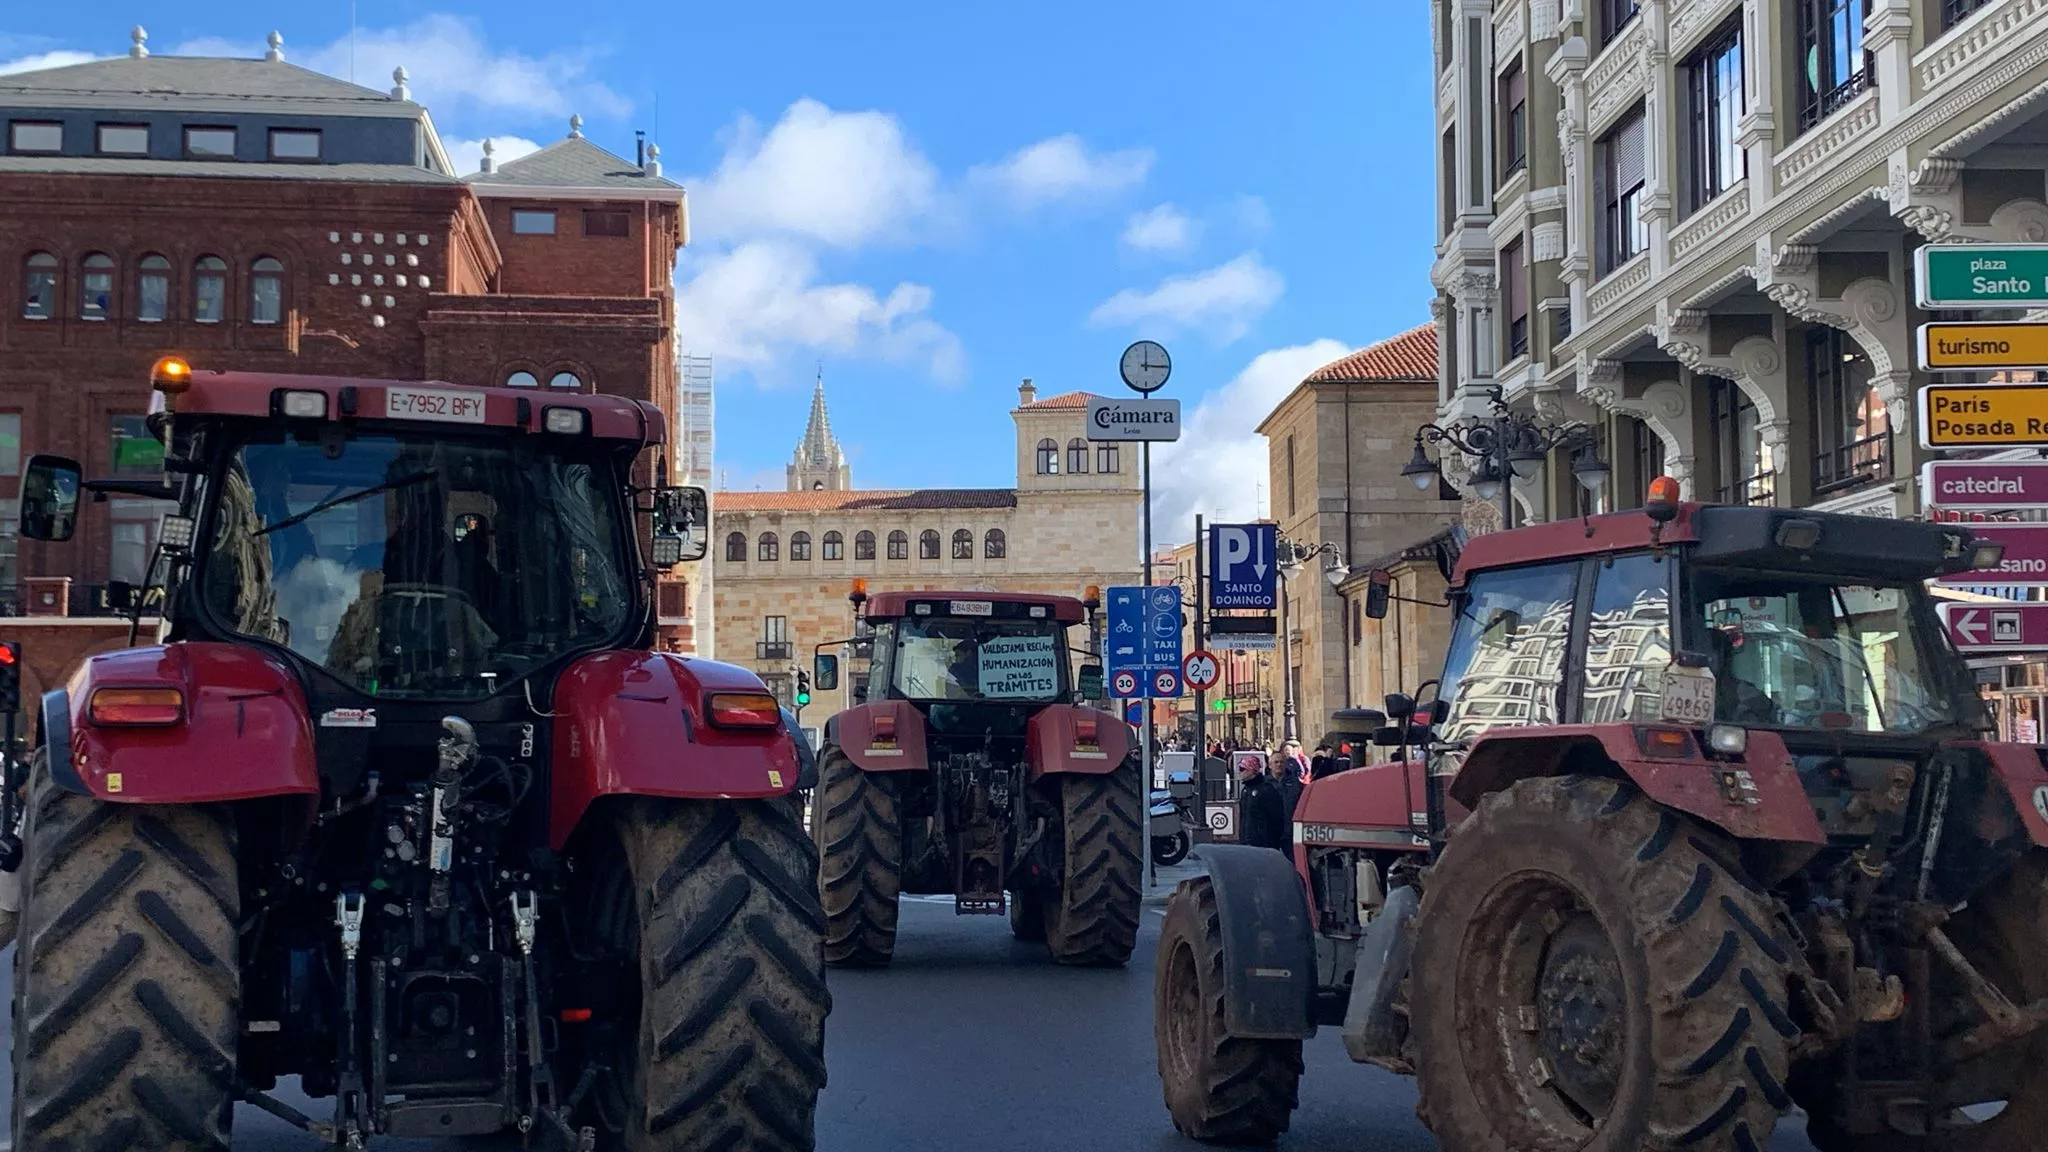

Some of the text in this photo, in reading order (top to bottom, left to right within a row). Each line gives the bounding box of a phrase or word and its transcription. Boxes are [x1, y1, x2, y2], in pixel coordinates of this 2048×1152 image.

[1970, 258, 2007, 273] plaza
[1972, 276, 2031, 294] Santo
[1937, 338, 2010, 355] turismo
[452, 397, 482, 417] BFY
[1936, 395, 1990, 414] París
[1937, 419, 2015, 436] Posada
[1942, 476, 2025, 494] catedral
[1218, 527, 1251, 582] P
[1225, 583, 1262, 593] SANTO
[1216, 595, 1272, 605] DOMINGO
[1153, 640, 1176, 649] TAXI
[1154, 653, 1175, 662] BUS
[1191, 664, 1200, 676] 2
[1118, 679, 1132, 688] 30
[1159, 679, 1173, 688] 20
[1215, 817, 1225, 825] 20
[1306, 825, 1335, 841] 5150
